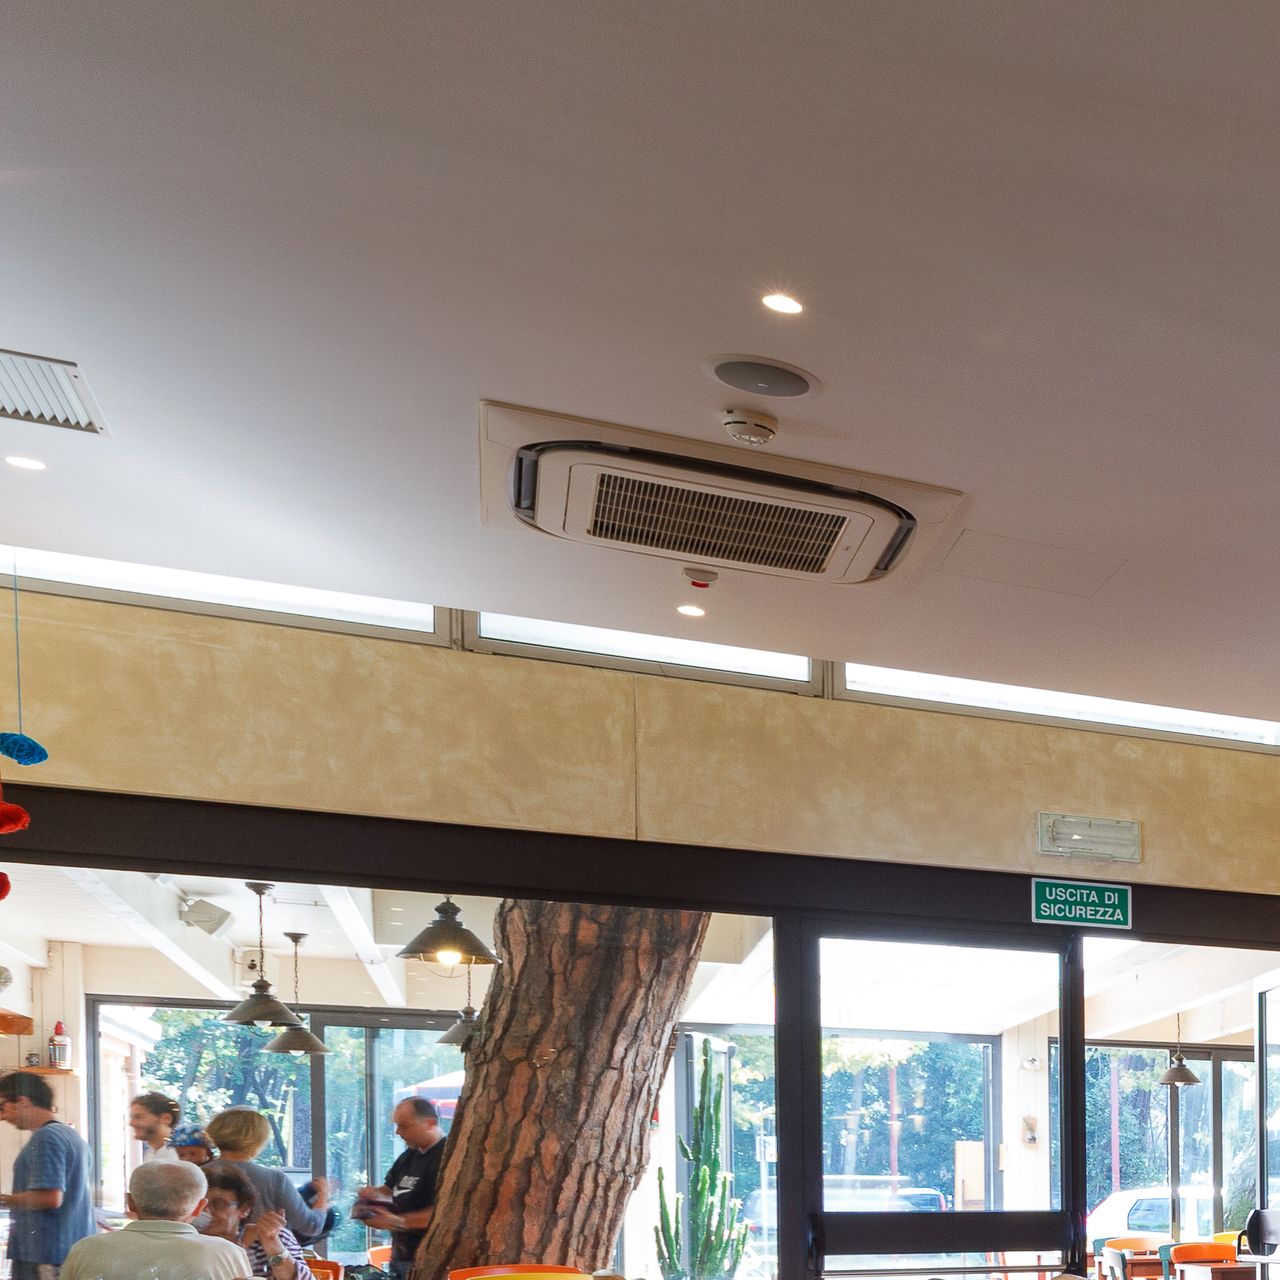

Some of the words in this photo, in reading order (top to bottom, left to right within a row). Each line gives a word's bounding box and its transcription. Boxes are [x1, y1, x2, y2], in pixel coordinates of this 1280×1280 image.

[1045, 886, 1099, 904] USCITA
[1104, 891, 1118, 905] DI
[1040, 902, 1124, 921] SICUREZZA
